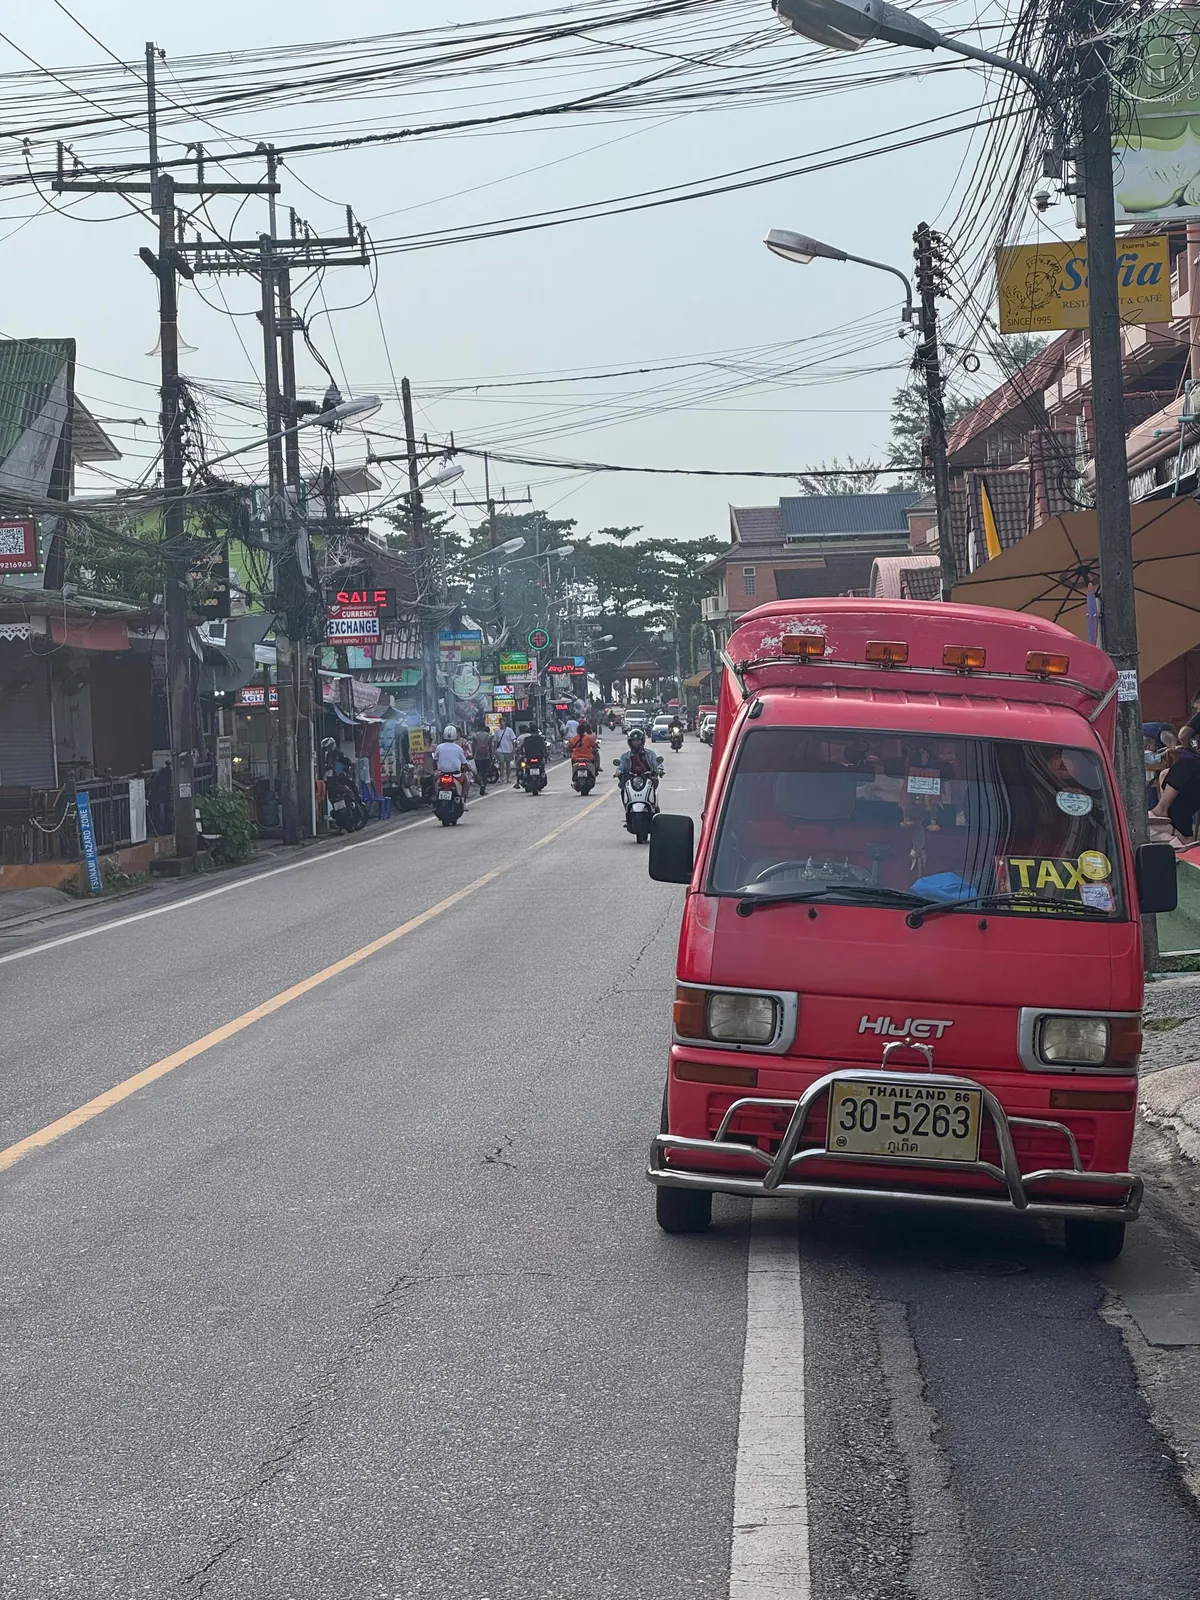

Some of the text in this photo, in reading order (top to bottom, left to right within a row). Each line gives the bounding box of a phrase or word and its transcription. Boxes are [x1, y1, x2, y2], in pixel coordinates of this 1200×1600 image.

[1058, 253, 1164, 292] Sfia
[1062, 297, 1126, 309] RESTT
[1136, 292, 1163, 304] CAFÉ
[1007, 316, 1052, 327] SINCE 1995
[0, 561, 32, 569] 9216965
[341, 610, 377, 618] CURRENCY
[329, 620, 378, 635] EXCHANGE
[80, 809, 99, 890] TSUNAMI HAZARD ZONE
[1009, 858, 1088, 890] TAX
[858, 1015, 954, 1039] HIJET
[867, 1086, 970, 1103] THAILAND 86
[839, 1097, 971, 1139] 30-5263
[887, 1137, 919, 1154] ภูเก็ต
